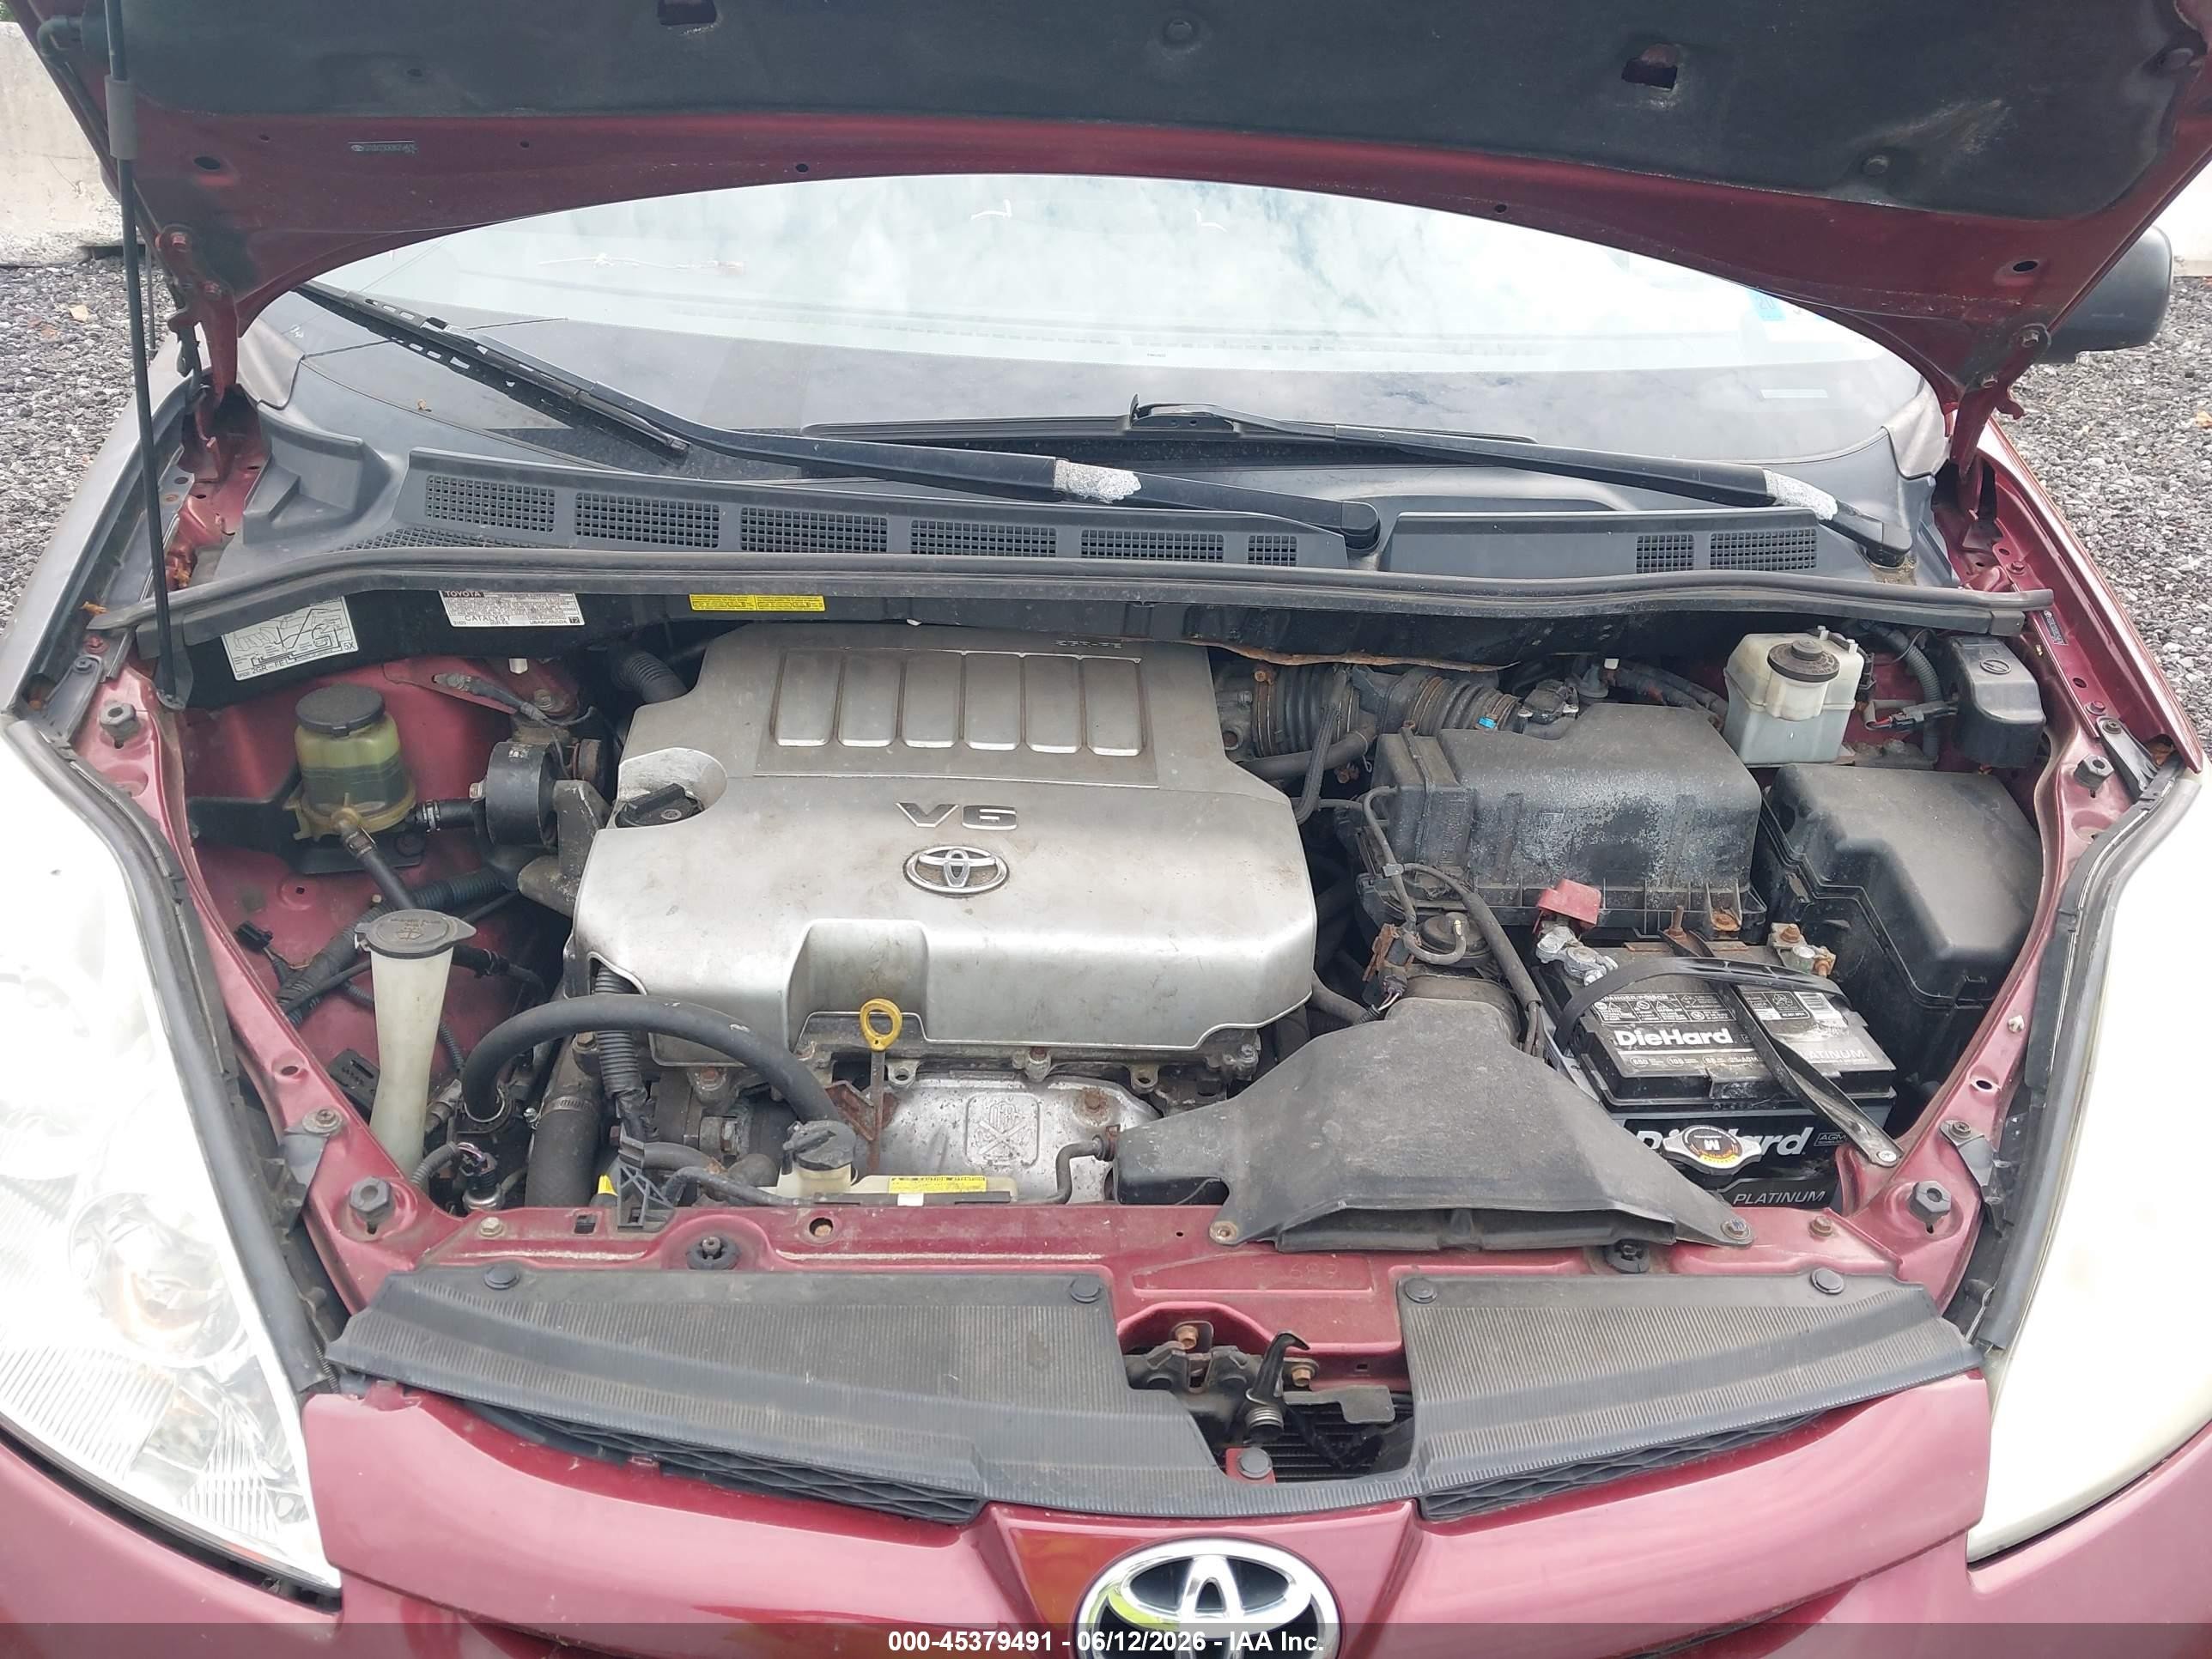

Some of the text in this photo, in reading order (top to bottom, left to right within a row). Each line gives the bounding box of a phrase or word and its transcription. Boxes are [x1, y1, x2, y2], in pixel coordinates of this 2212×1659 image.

[896, 802, 1018, 830] V6
[1613, 1028, 1734, 1046] DieHard
[1799, 1049, 1865, 1060] LATINUM
[1733, 1190, 1826, 1206] PLATINUM
